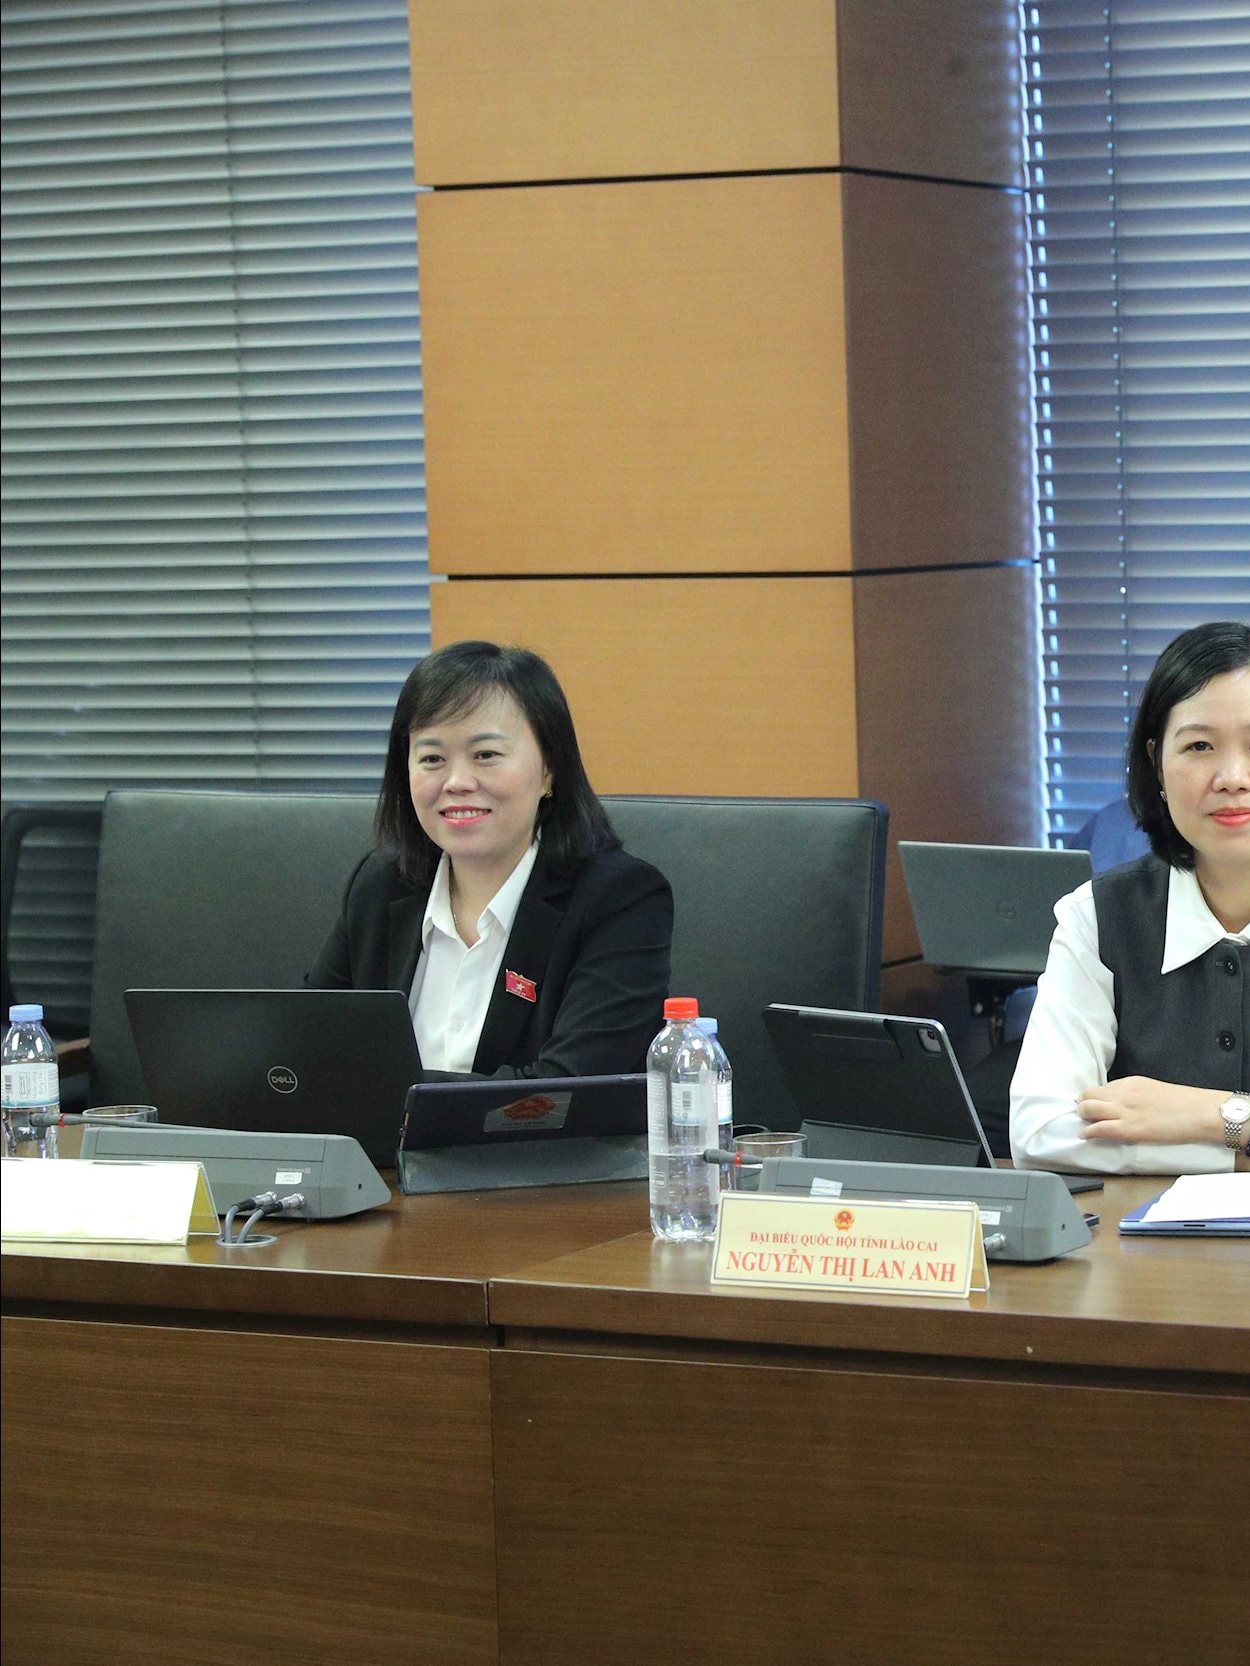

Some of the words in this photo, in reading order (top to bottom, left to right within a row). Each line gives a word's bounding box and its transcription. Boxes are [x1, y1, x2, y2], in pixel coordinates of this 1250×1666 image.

[271, 1075, 295, 1084] DELL
[750, 1231, 769, 1245] ĐẠI
[801, 1232, 833, 1247] QUỐC
[836, 1236, 857, 1250] HỘI
[890, 1237, 914, 1250] LÀO
[917, 1240, 938, 1252] CAI
[726, 1248, 814, 1274] NGUYỄN
[820, 1256, 856, 1282] THỊ
[862, 1258, 905, 1280] LAN
[909, 1261, 956, 1282] ANH
